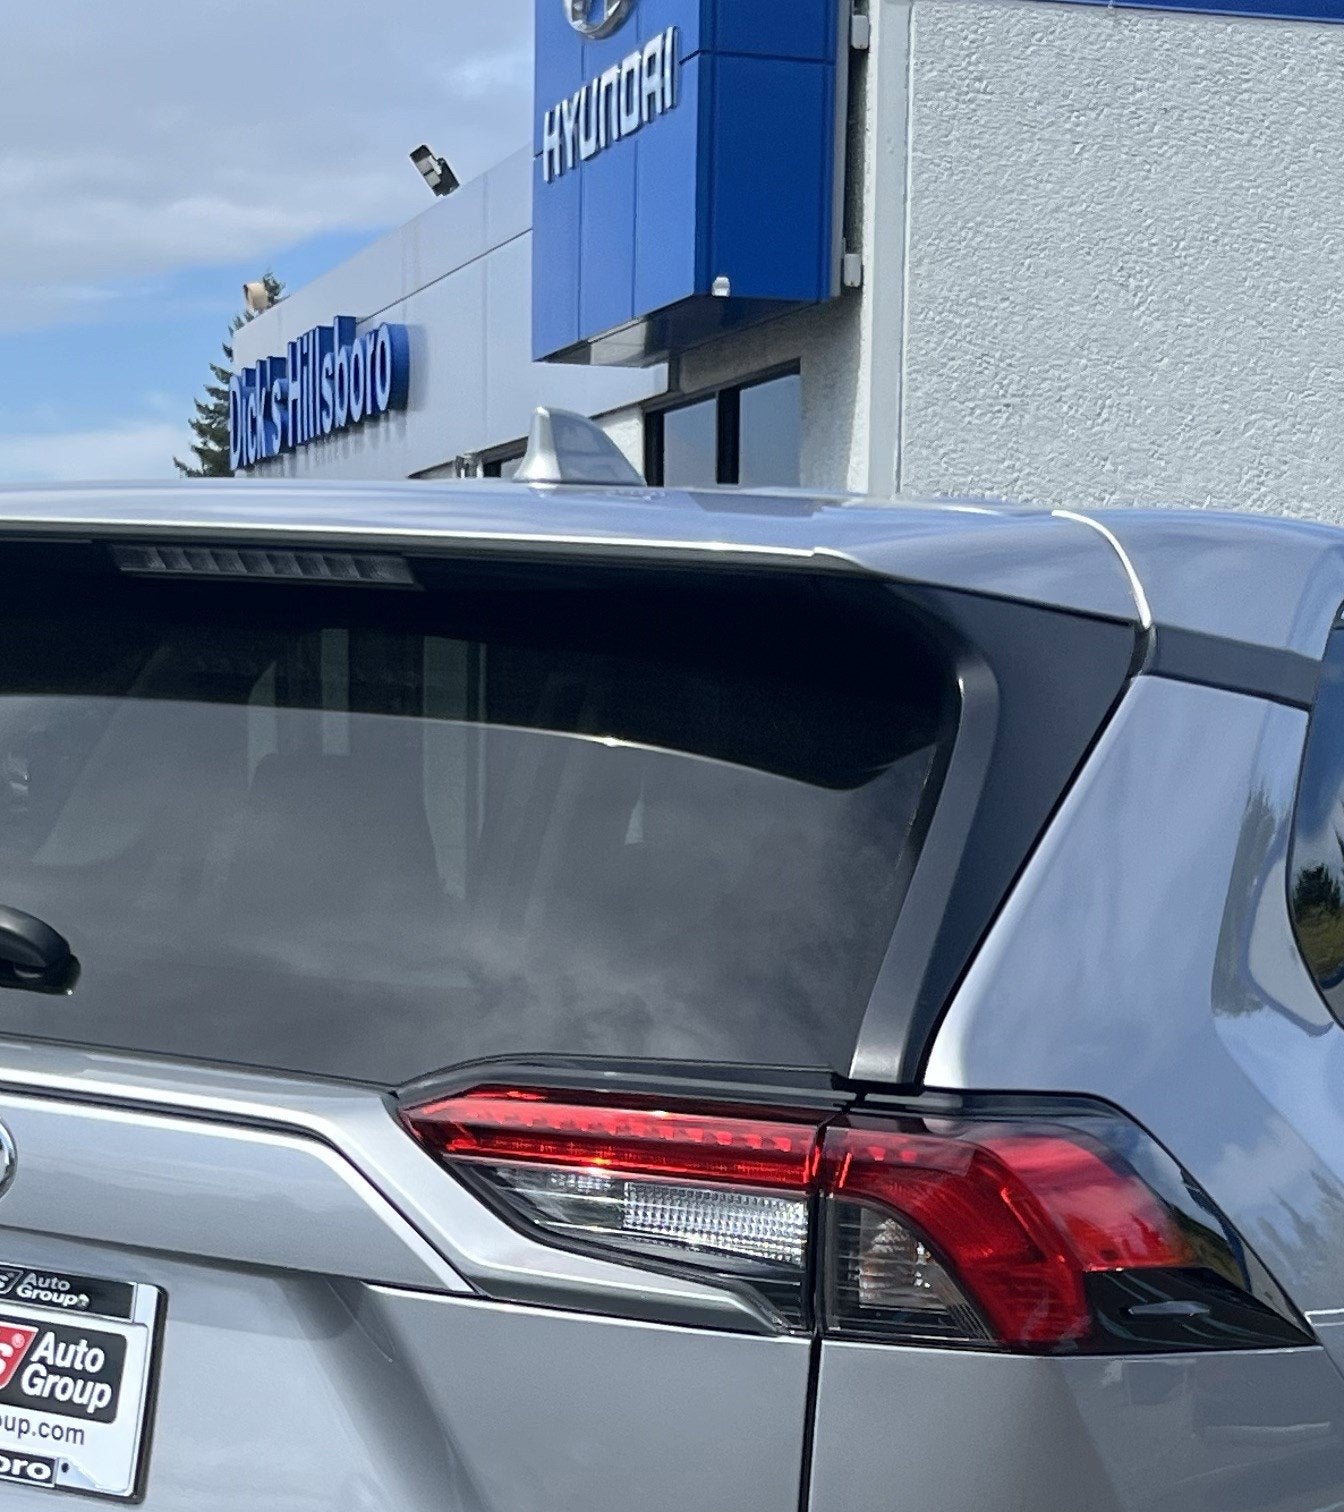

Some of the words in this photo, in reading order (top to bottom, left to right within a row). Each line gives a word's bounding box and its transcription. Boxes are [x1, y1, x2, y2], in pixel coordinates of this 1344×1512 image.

[543, 26, 677, 183] HYUNDAI
[229, 357, 283, 471] Dick's
[287, 315, 396, 447] Hillsboro
[16, 1284, 79, 1308] Group
[25, 1272, 72, 1292] Auto
[30, 1331, 106, 1374] Auto
[21, 1364, 113, 1415] Group
